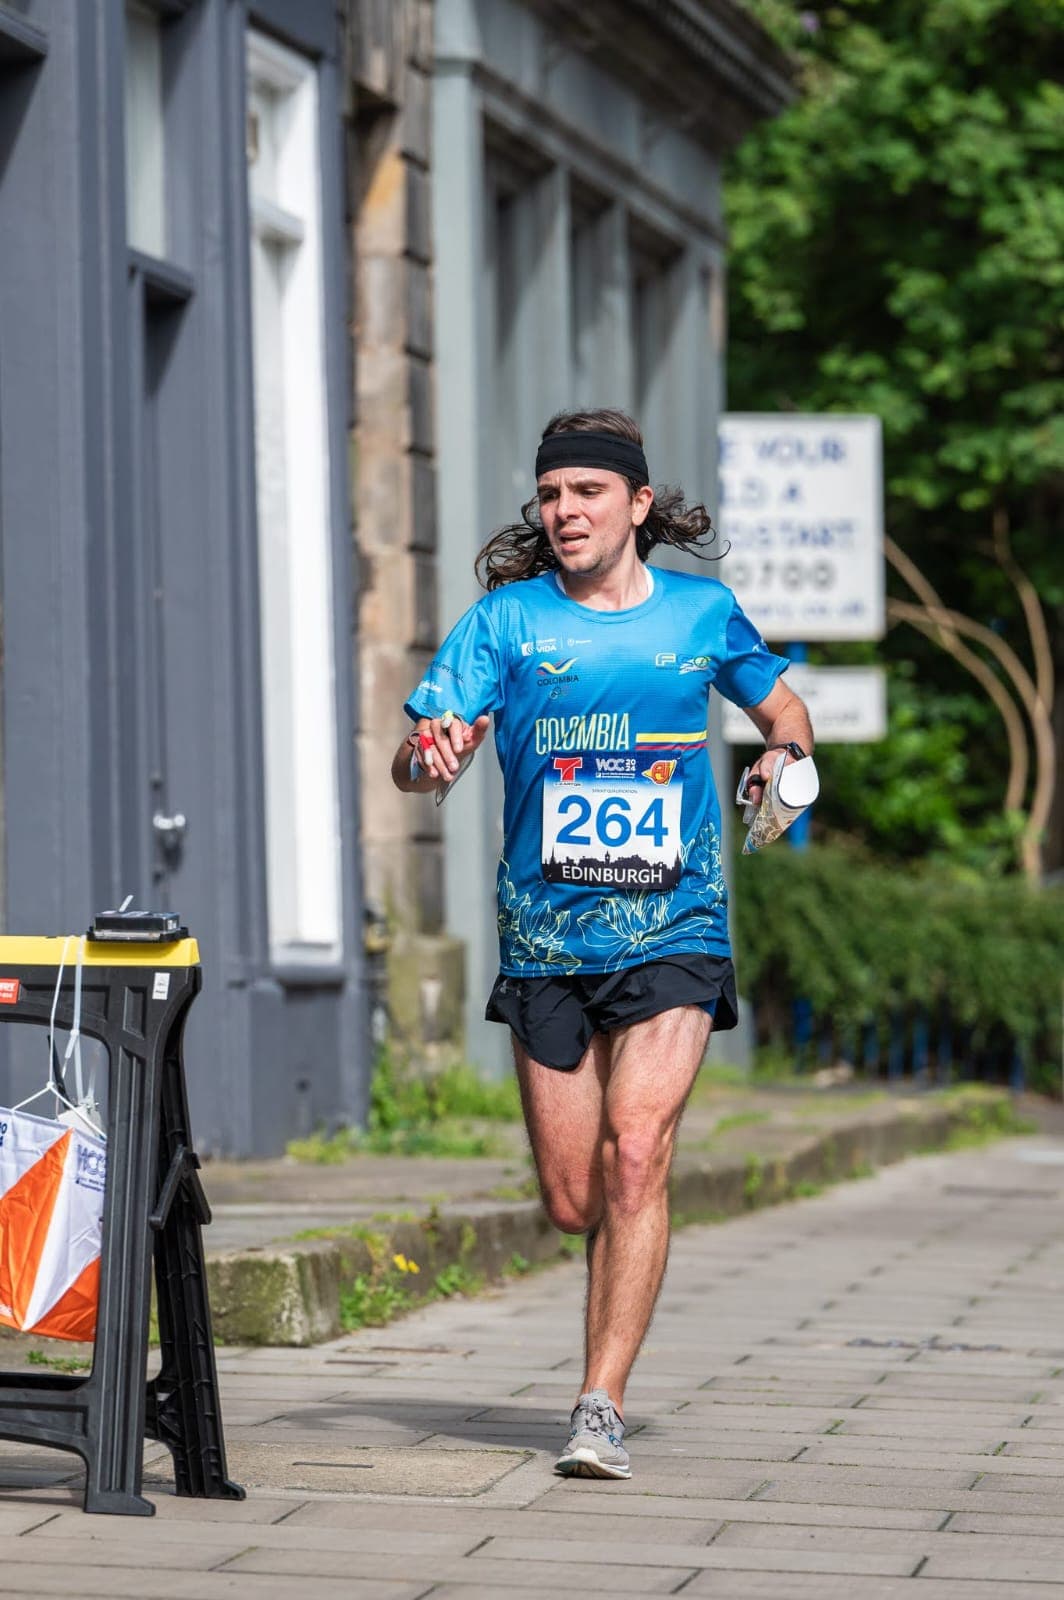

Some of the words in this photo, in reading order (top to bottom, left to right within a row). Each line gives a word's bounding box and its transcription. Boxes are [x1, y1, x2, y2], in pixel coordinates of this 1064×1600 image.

[537, 675, 580, 687] COLOMBIA
[535, 712, 630, 755] COLOMBIA
[595, 758, 625, 771] WOC
[556, 794, 669, 848] 264
[562, 865, 664, 884] EDINBURGH
